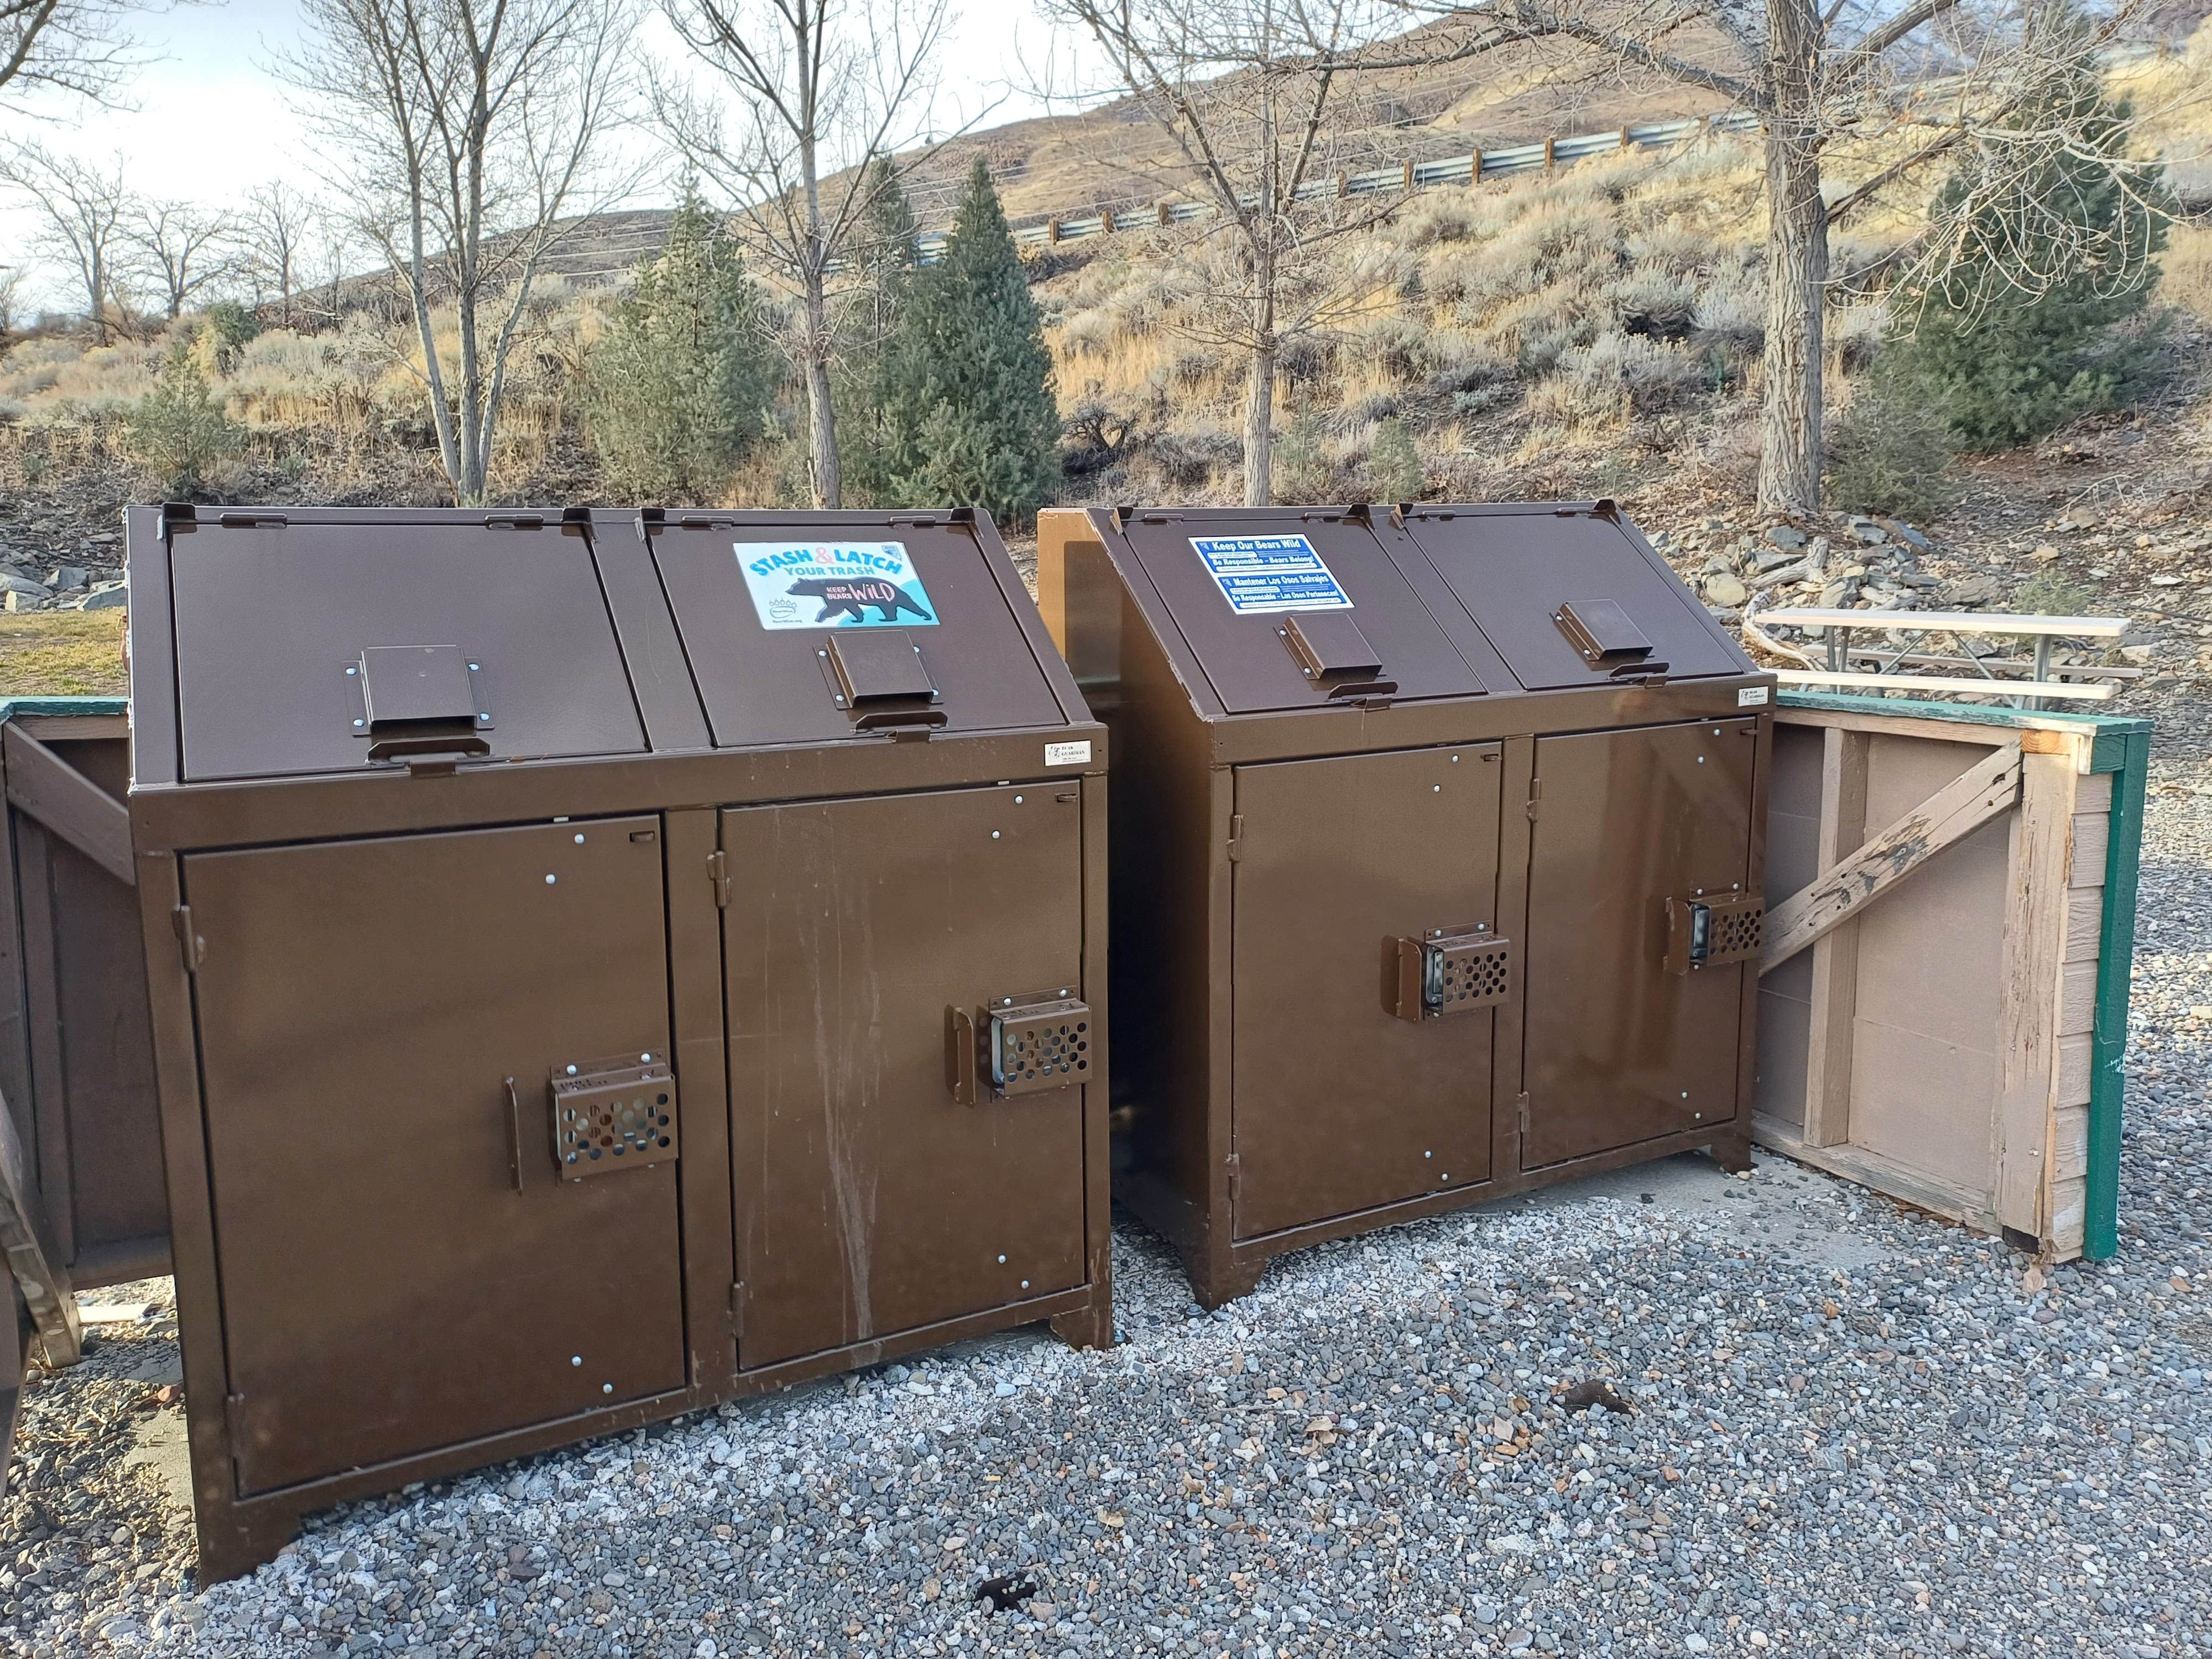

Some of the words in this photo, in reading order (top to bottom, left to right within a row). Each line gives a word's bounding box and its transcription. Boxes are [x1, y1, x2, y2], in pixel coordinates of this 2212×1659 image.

[1213, 541, 1236, 551] Keep
[1238, 541, 1253, 550] Our
[1256, 540, 1281, 549] Bears
[1282, 539, 1301, 548] Wild
[749, 549, 812, 576] STASH
[815, 546, 834, 565] &
[835, 549, 902, 574] LATCH
[1224, 557, 1264, 566] Responsible
[784, 566, 826, 576] YOUR
[830, 566, 875, 576] TRASH
[1233, 578, 1267, 586] Mantener
[1267, 577, 1281, 585] Los
[1281, 576, 1300, 584] Osos
[1300, 574, 1329, 585] Salvajes
